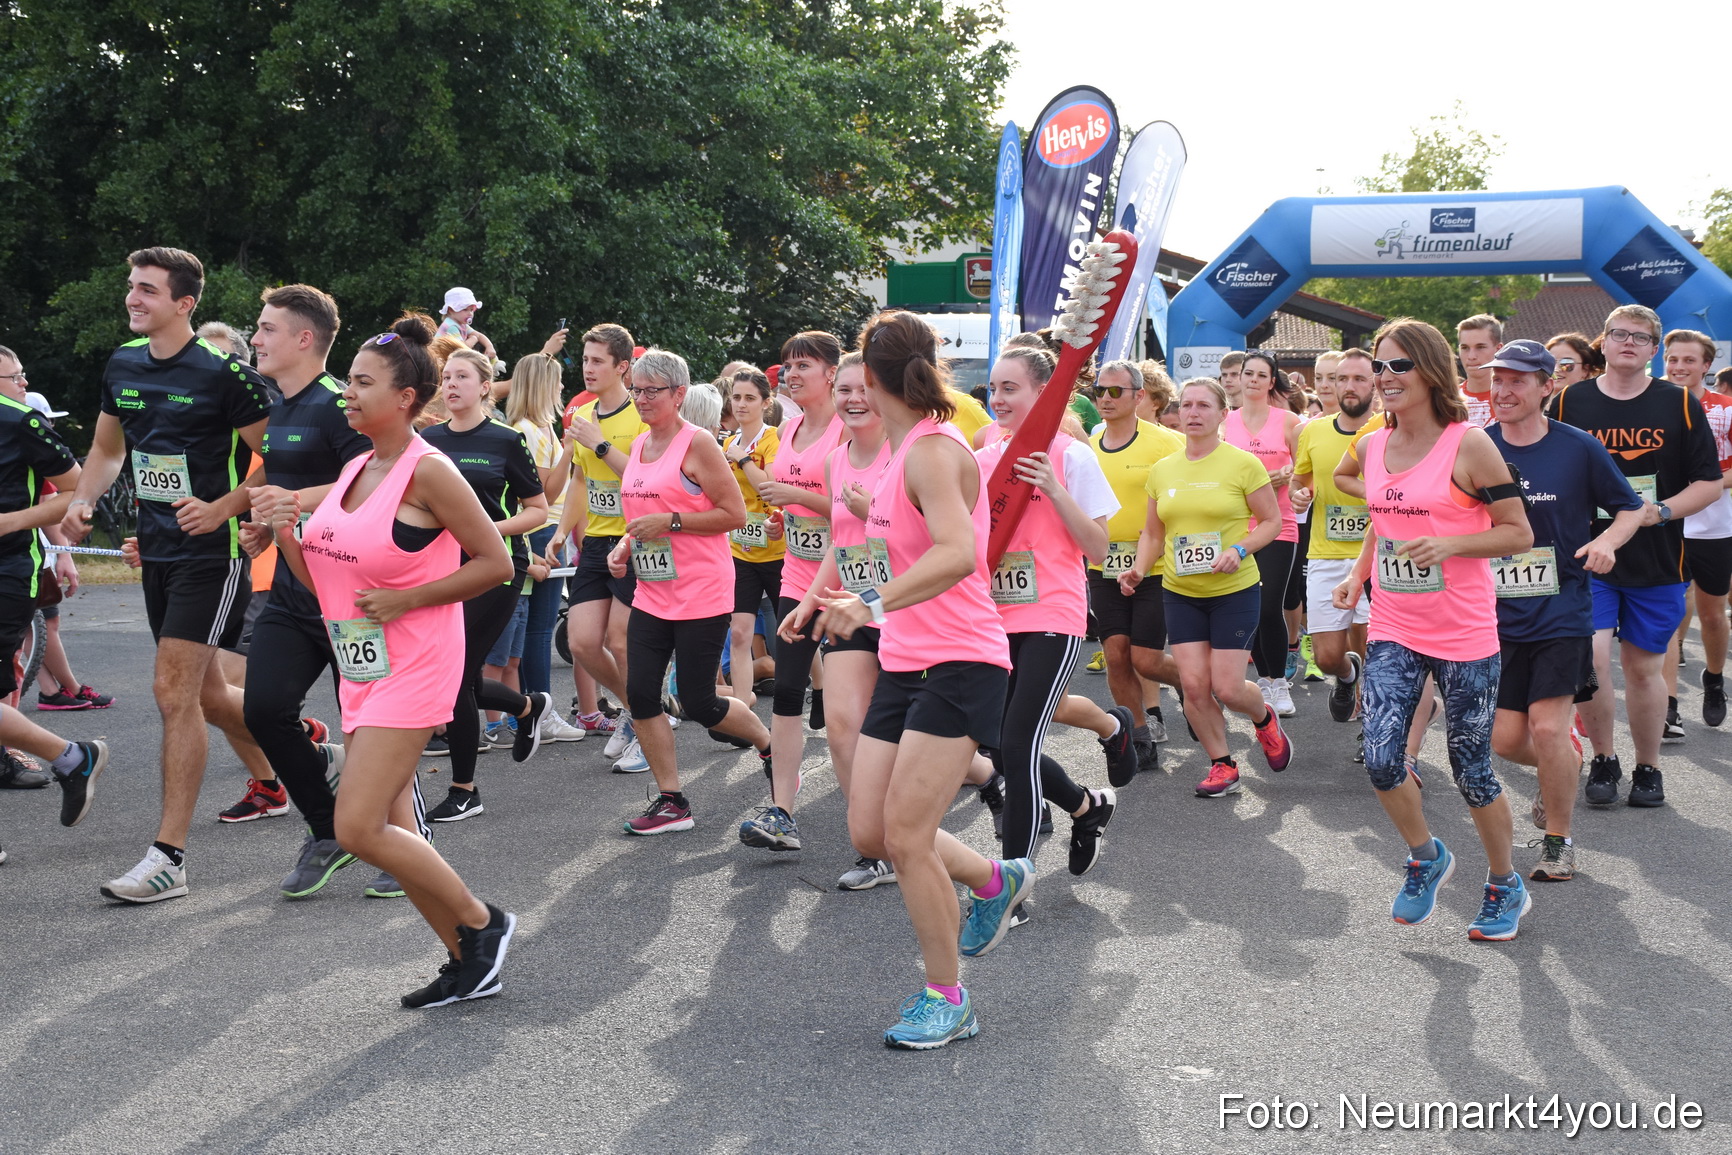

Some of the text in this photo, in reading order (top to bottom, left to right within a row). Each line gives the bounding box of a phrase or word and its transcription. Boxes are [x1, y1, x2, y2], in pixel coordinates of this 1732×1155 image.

[1044, 115, 1107, 155] Hervis
[1135, 144, 1168, 234] Fischer
[1440, 216, 1474, 225] Fischer
[1413, 232, 1515, 252] firmenlauf
[1050, 172, 1103, 331] TMOVIN
[1226, 270, 1278, 282] Fischer
[1119, 282, 1146, 360] er-automobile.de
[121, 388, 139, 398] JAKO
[167, 394, 194, 405] DOMINIK
[1586, 427, 1665, 448] WINGS
[459, 457, 490, 466] ANNALENA
[790, 464, 802, 476] Die
[139, 469, 182, 490] 2099
[633, 478, 644, 488] Die
[1519, 477, 1530, 490] ie
[589, 490, 616, 507] 2193
[1386, 488, 1404, 501] Die
[1369, 503, 1430, 519] eferorthopäden
[736, 524, 762, 538] 695
[1330, 518, 1365, 531] 2195
[321, 526, 335, 542] Die
[787, 527, 823, 549] 1123
[635, 553, 668, 570] 1114
[1178, 546, 1215, 565] 1259
[1382, 557, 1431, 579] 1119
[1496, 565, 1547, 585] 1117
[991, 570, 1028, 590] 116
[336, 640, 377, 665] 1126
